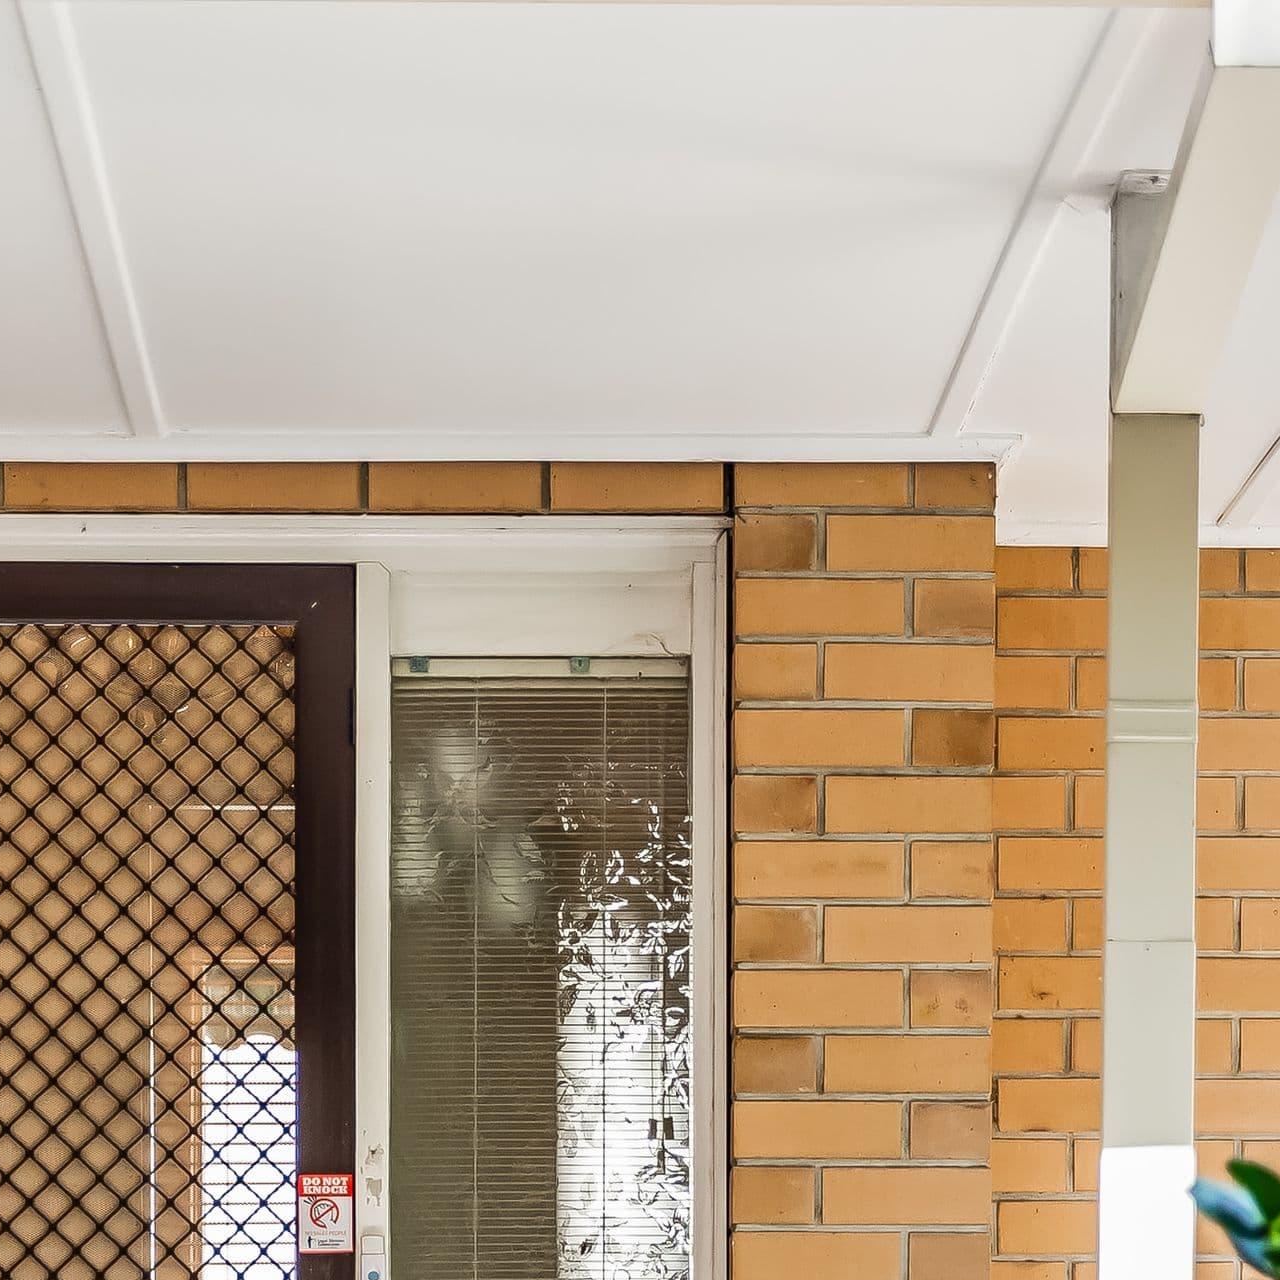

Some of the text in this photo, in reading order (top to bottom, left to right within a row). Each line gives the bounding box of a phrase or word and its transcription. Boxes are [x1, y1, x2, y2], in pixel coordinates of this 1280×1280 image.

[302, 1177, 349, 1186] DO NOT
[303, 1185, 348, 1195] KNOCK
